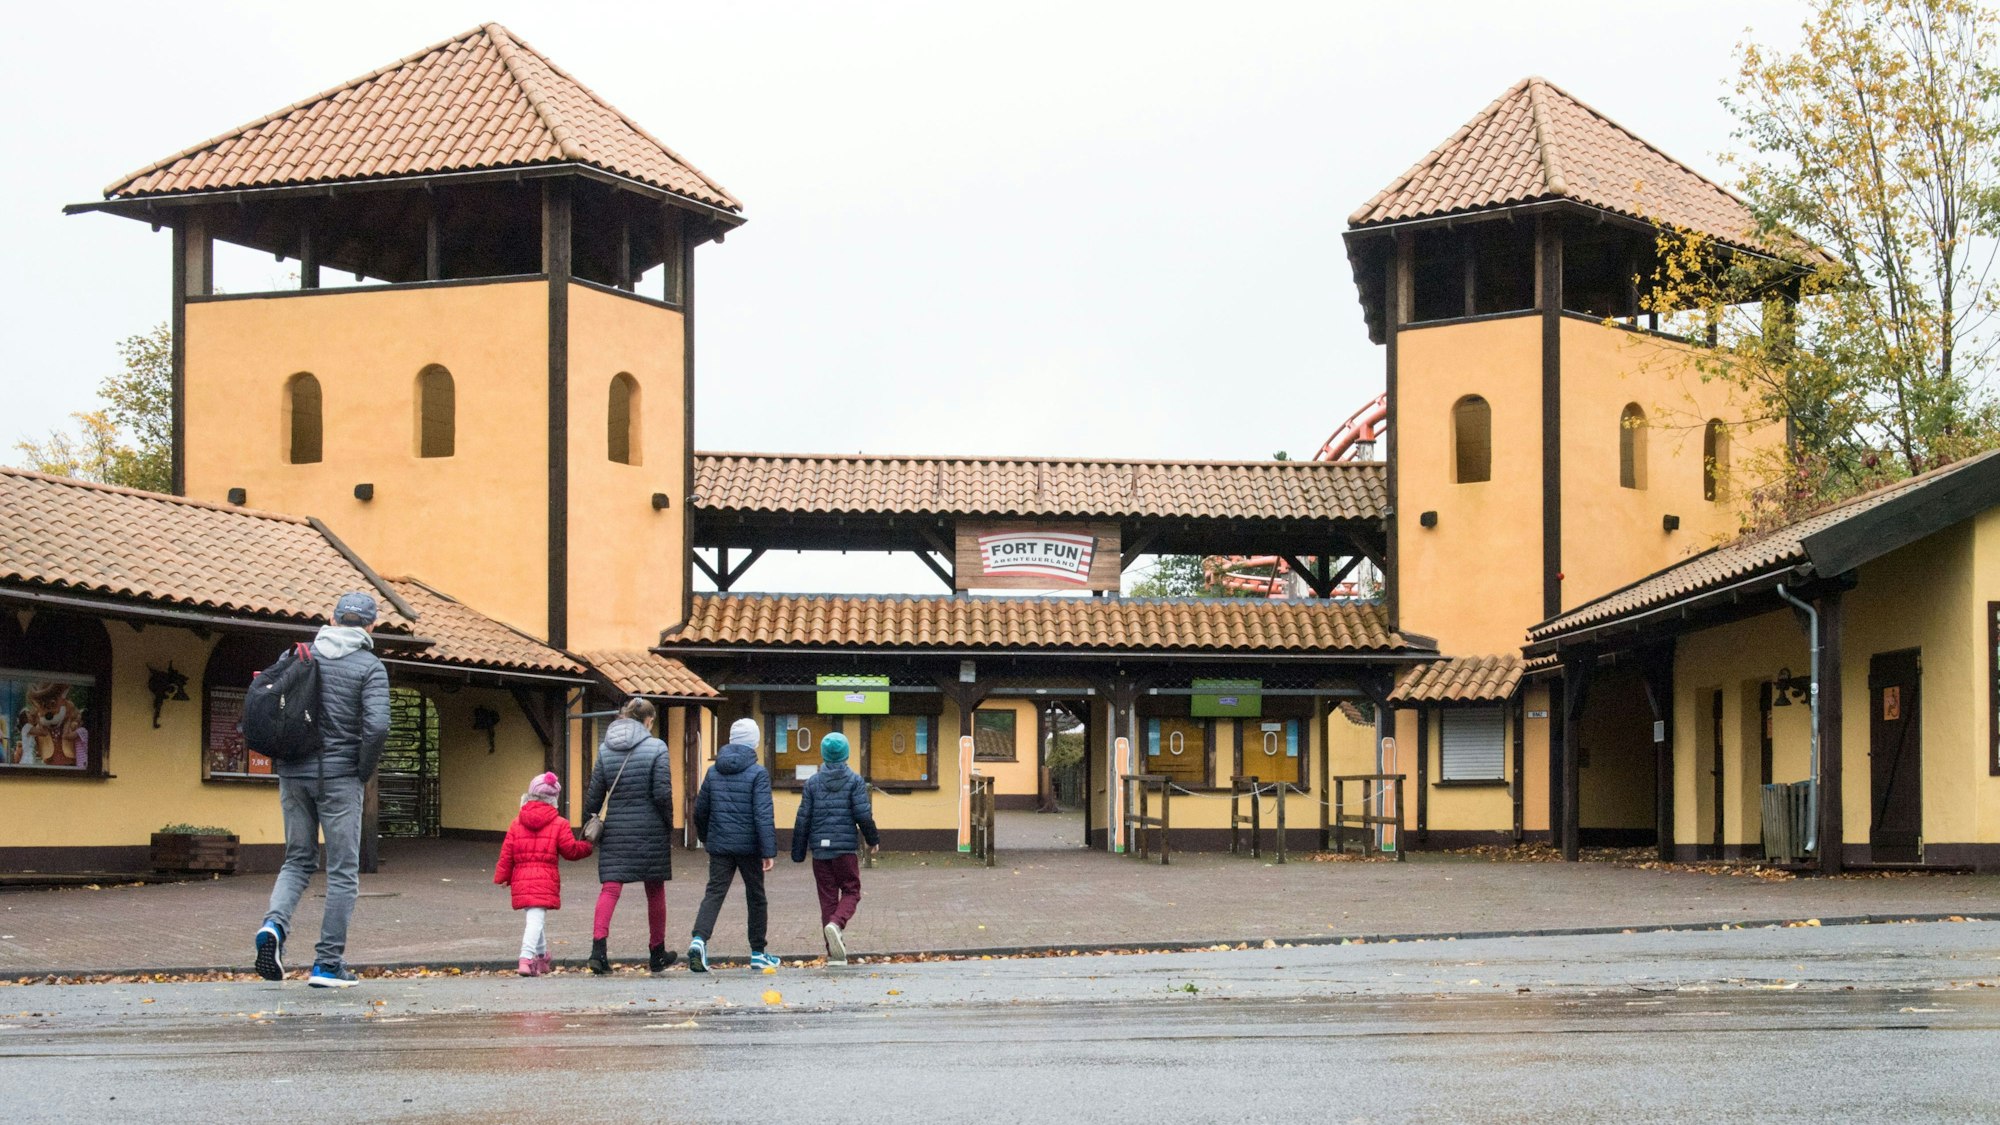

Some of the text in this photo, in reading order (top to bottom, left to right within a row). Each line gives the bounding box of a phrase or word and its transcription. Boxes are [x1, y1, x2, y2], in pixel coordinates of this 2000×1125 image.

[991, 542, 1078, 560] FORT FUN
[994, 557, 1075, 568] ABENTEUERLAND
